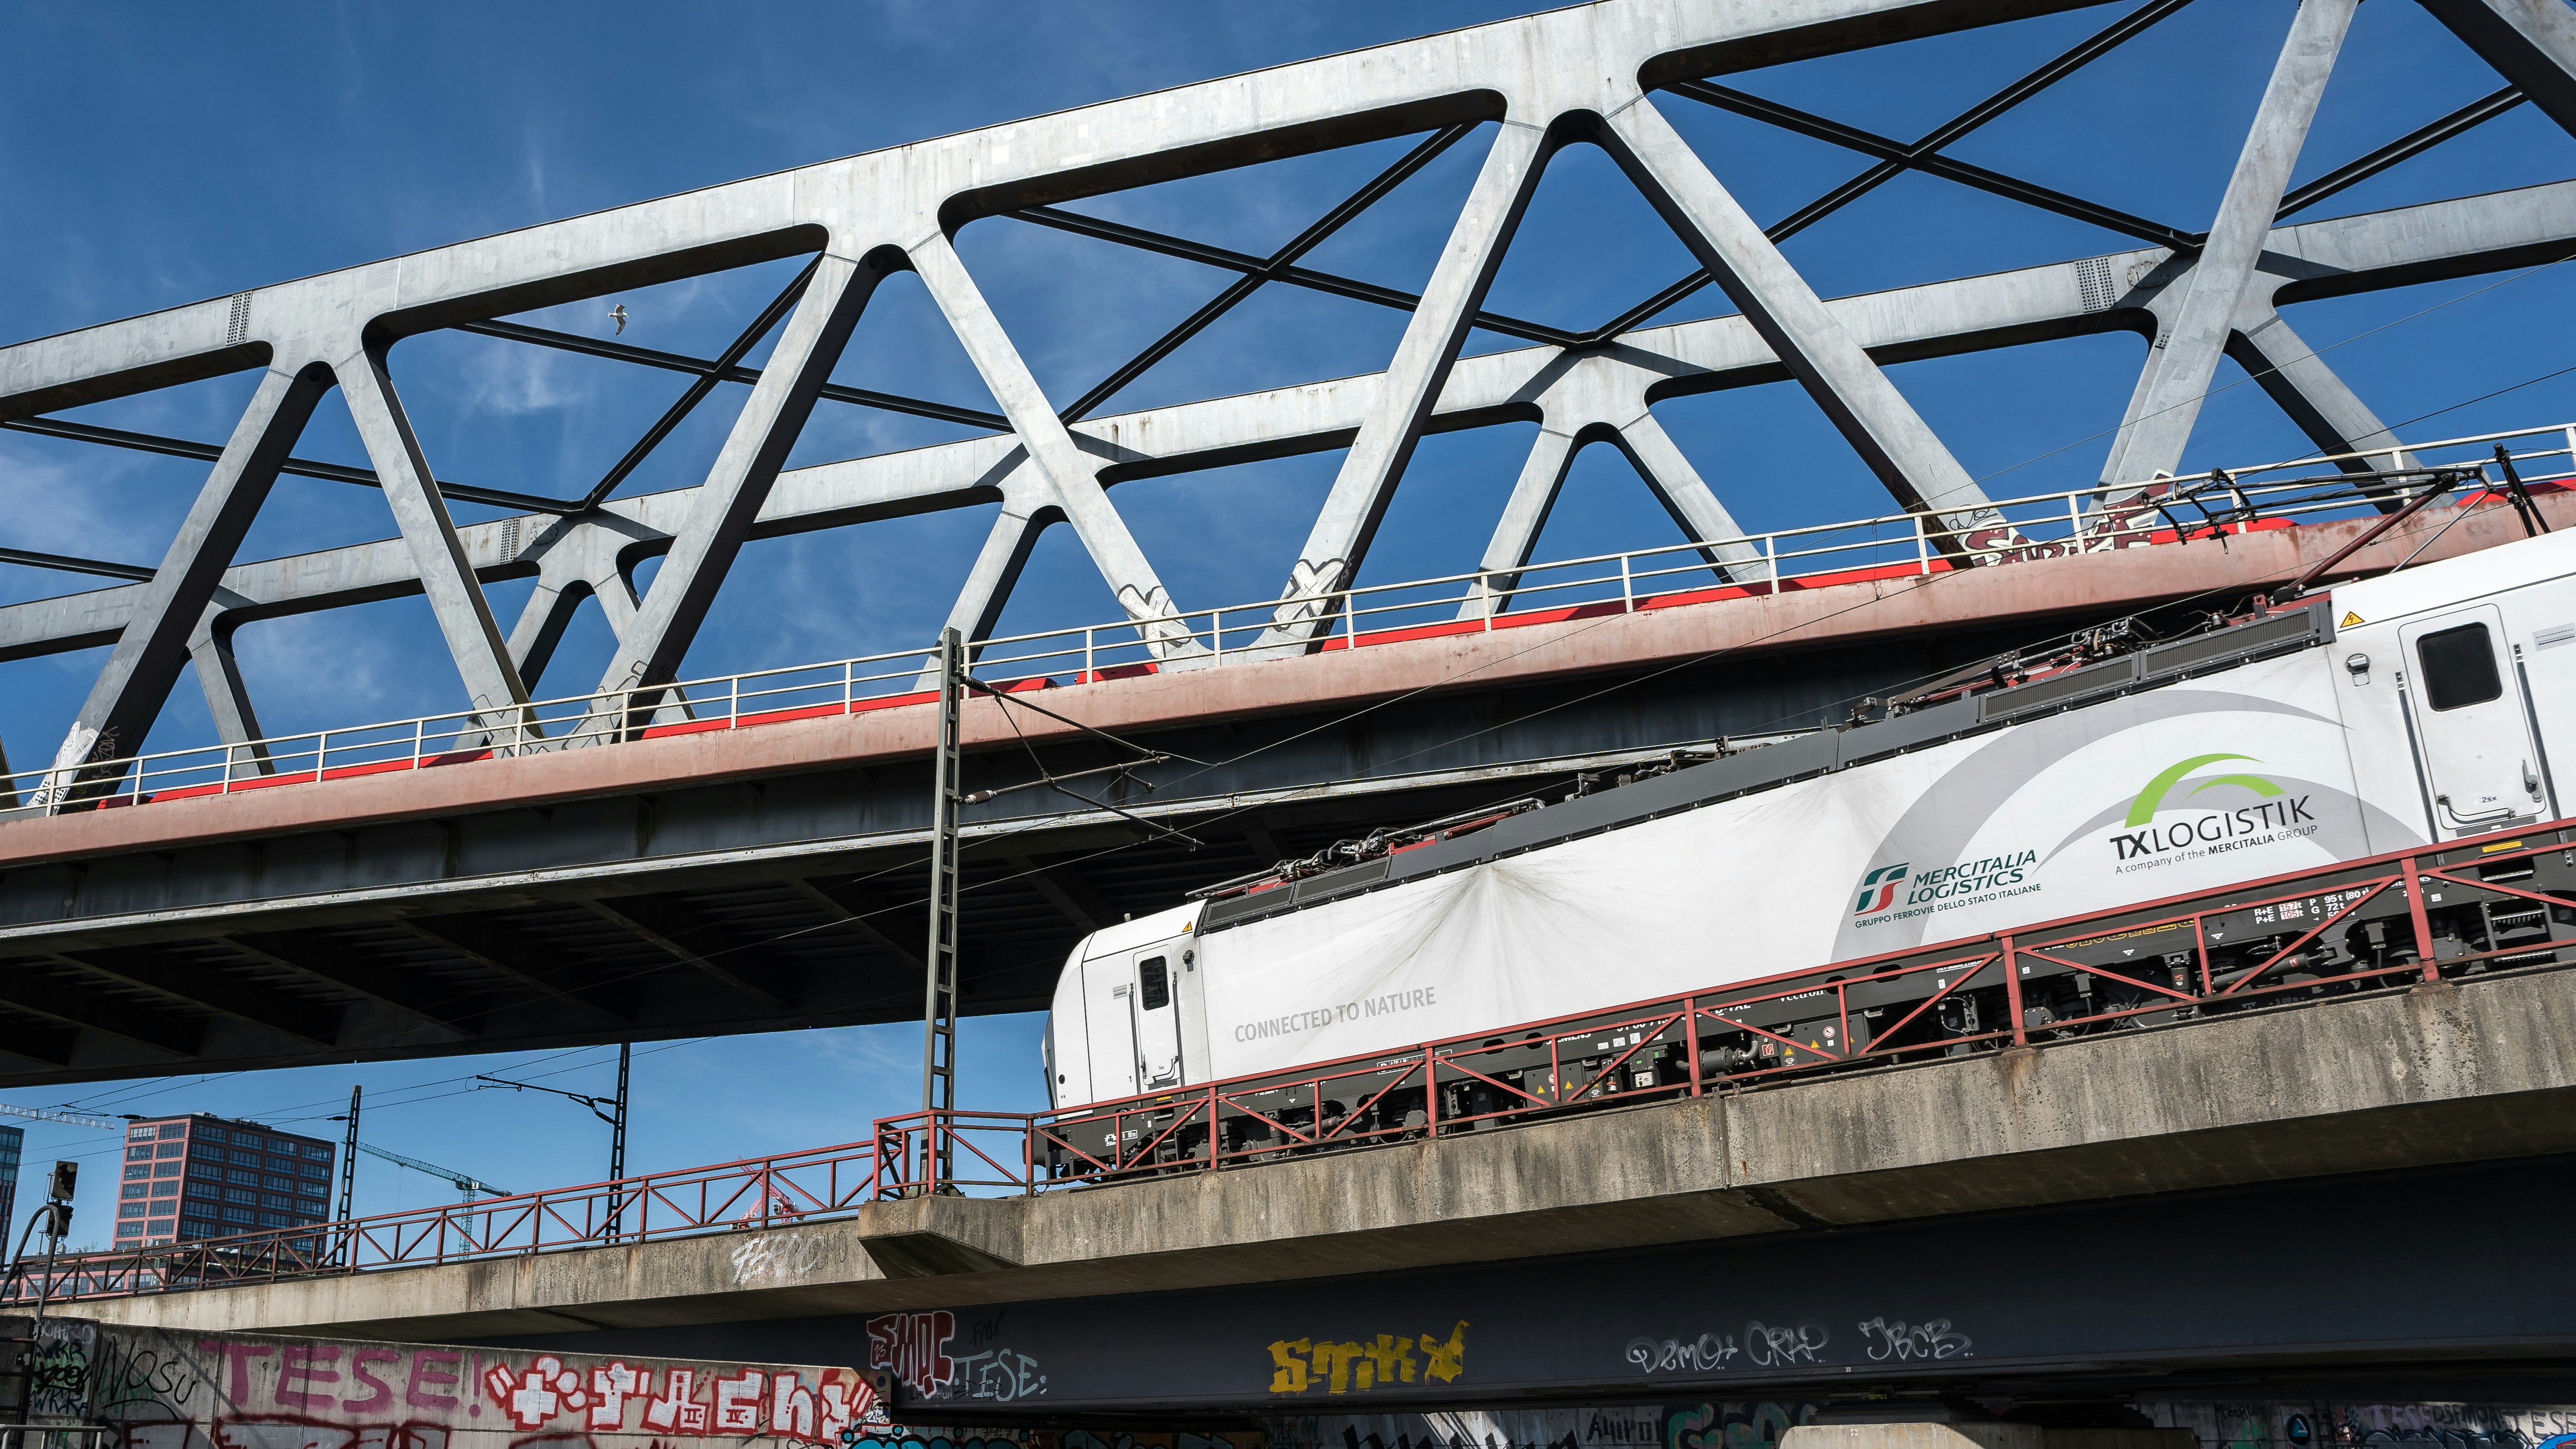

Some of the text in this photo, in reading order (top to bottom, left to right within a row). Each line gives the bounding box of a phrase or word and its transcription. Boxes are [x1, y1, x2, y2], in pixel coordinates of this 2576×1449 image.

[1913, 850, 2036, 888] MERCITALIA
[2115, 825, 2317, 875] A company of the MERCITALIA GROUP
[1855, 883, 2041, 928] GRUPPO FERROVIE DELLO STATO ITALIANE
[1907, 868, 2024, 905] LOGISTICS
[2254, 907, 2274, 917] R+E
[2309, 899, 2316, 907] P
[2255, 915, 2276, 924] P+E
[1235, 986, 1436, 1043] CONNECTED TO NATURE
